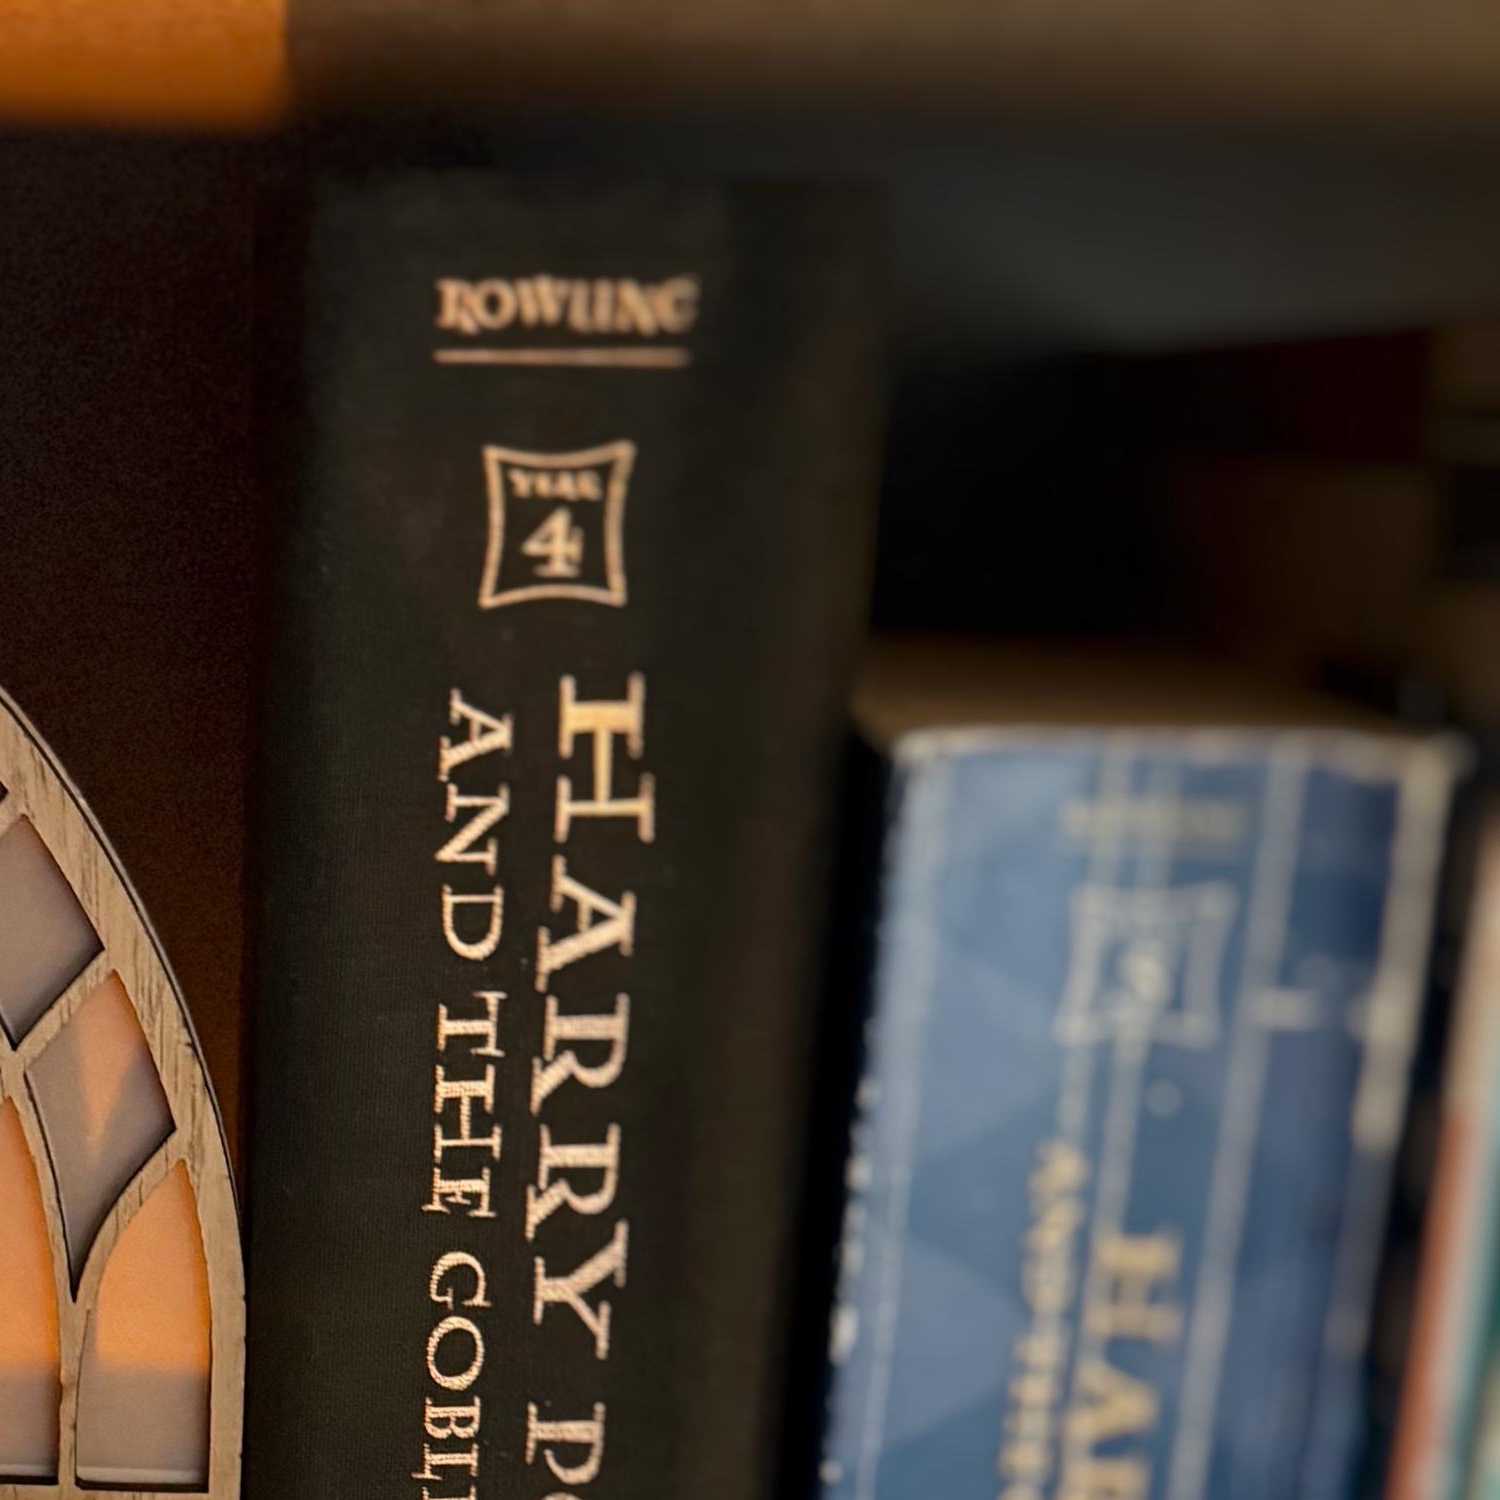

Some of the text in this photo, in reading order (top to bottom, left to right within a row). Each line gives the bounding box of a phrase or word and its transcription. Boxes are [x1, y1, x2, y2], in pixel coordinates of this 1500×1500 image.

[435, 274, 699, 335] ROWLING
[507, 467, 602, 499] YEAR
[520, 507, 584, 578] 4
[434, 687, 512, 960] AND
[525, 670, 656, 1359] HARRY
[422, 990, 507, 1218] THE
